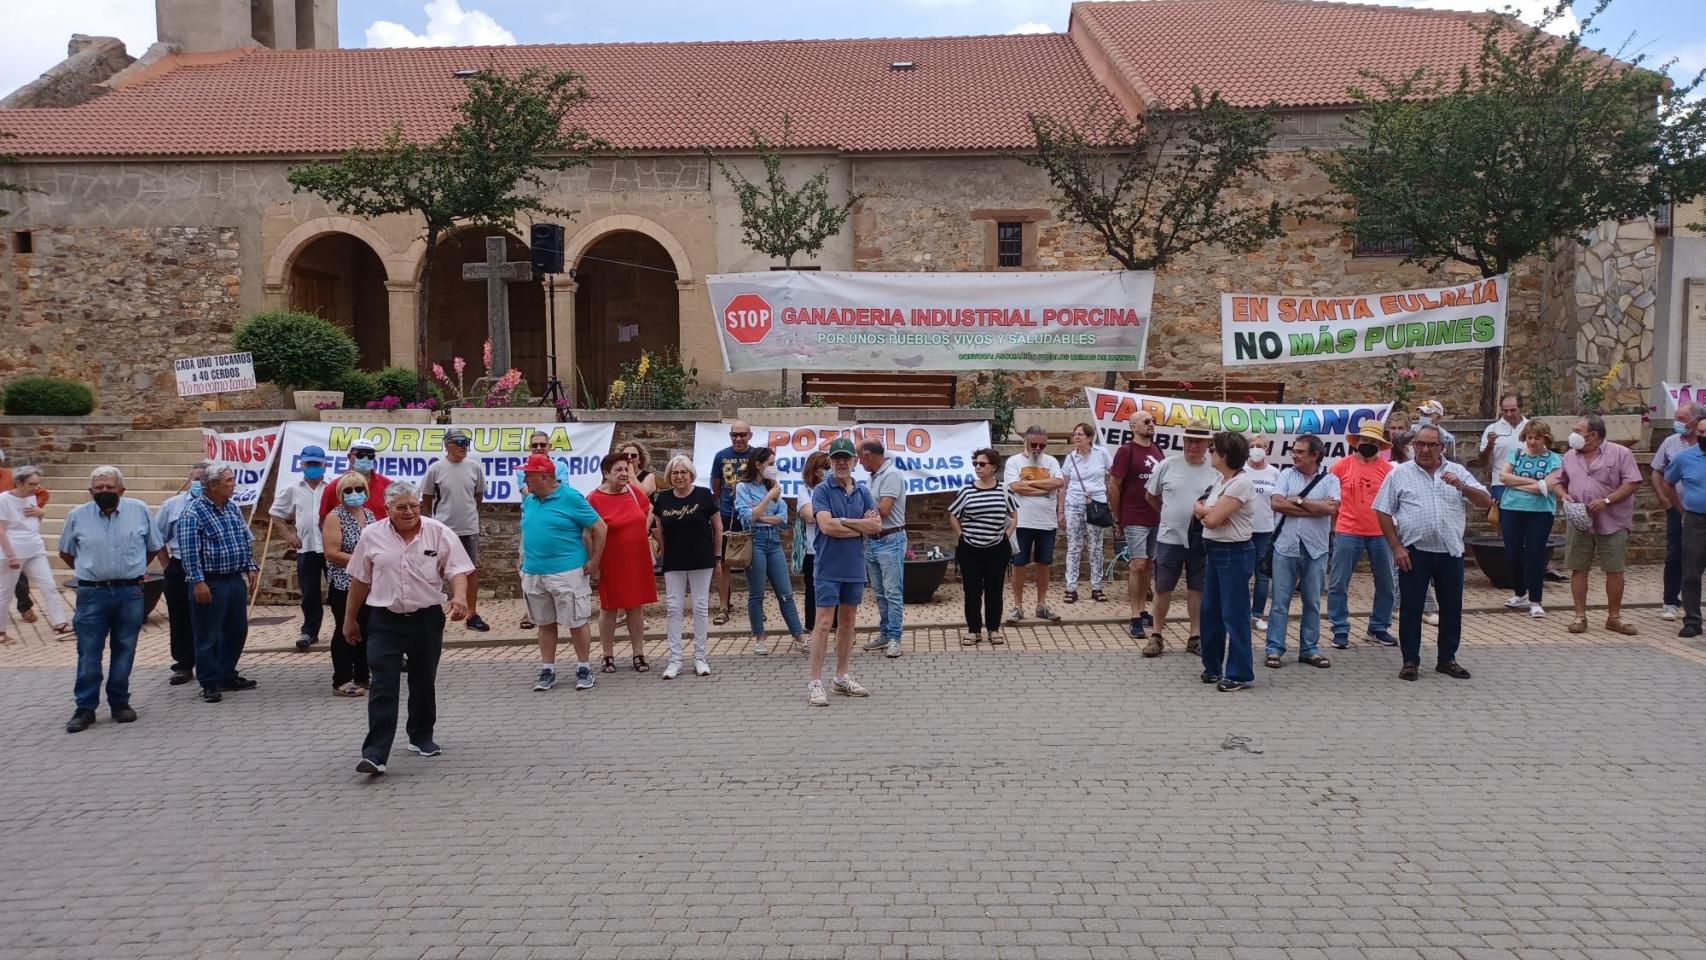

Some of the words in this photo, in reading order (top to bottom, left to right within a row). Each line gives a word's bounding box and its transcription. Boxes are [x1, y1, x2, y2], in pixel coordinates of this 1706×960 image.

[1232, 297, 1269, 322] EN
[1280, 298, 1375, 323] SANTA
[1380, 280, 1499, 315] EULALIA
[727, 309, 770, 329] STOP
[781, 307, 906, 326] GANADERIA
[911, 308, 1037, 327] INDUSTRIAL
[1043, 308, 1140, 327] PORCINA
[818, 333, 845, 345] POR
[849, 333, 885, 345] UNOS
[889, 333, 950, 345] PUEBLOS
[954, 334, 991, 345] VIVOS
[993, 334, 1004, 345] Y
[1008, 334, 1096, 345] SALUDABLES
[1234, 331, 1283, 361] NO
[1289, 326, 1358, 357] MÁS
[1364, 315, 1496, 351] PURINES
[175, 360, 195, 371] CADA
[197, 357, 212, 368] UNO
[214, 352, 252, 366] TOCAMOS
[192, 373, 198, 382] a
[199, 370, 209, 381] 40
[210, 367, 240, 380] CERDOS
[193, 383, 204, 393] no
[205, 381, 229, 393] como
[329, 426, 572, 452] MOREUELA
